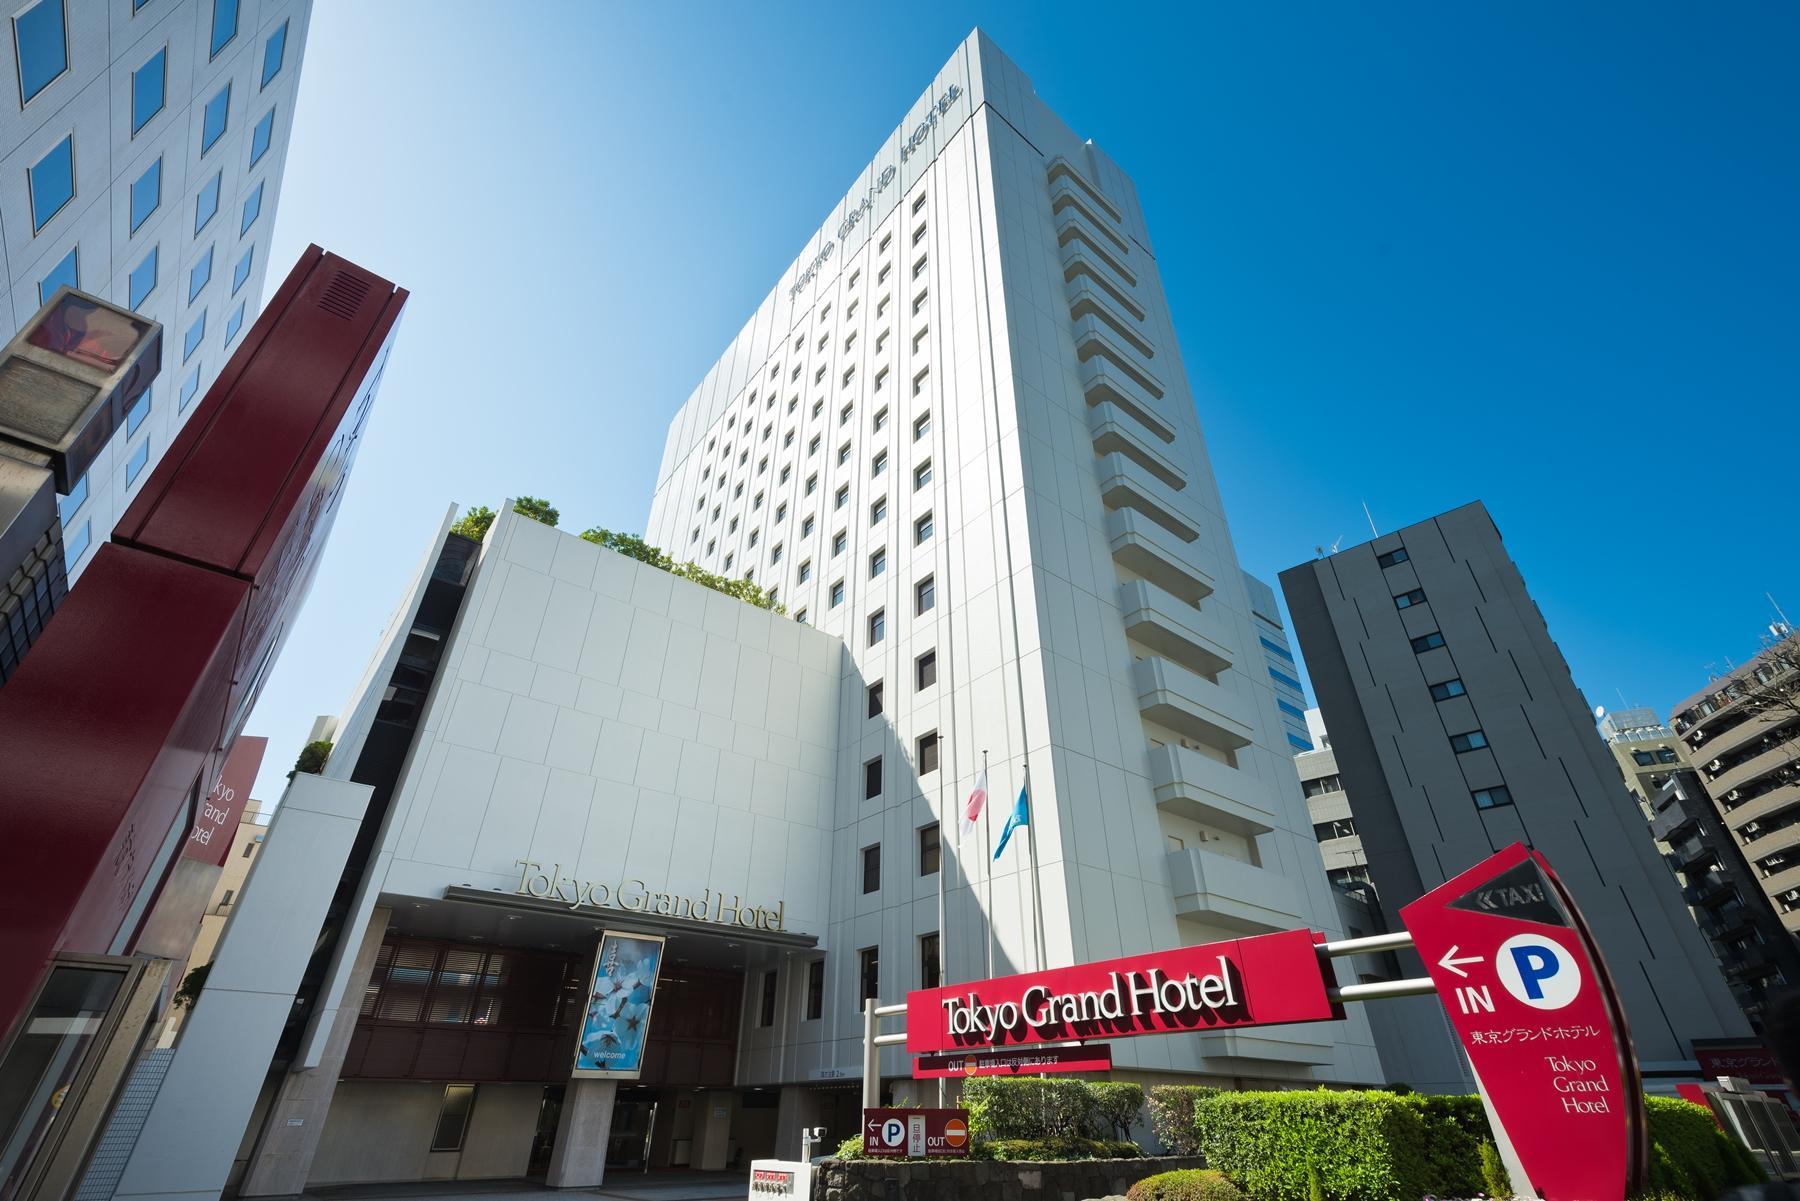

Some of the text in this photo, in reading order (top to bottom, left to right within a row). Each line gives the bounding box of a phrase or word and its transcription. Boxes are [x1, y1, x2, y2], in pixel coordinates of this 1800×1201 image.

[838, 163, 897, 241] GRAND
[900, 84, 964, 164] HOTEL
[515, 859, 785, 932] Tokyo Grand Hotel
[1495, 883, 1544, 907] TAXI
[1510, 945, 1560, 1000] P
[942, 955, 1239, 1041] Tokyo Grand Hotel
[1455, 985, 1496, 1015] IN
[1470, 1025, 1600, 1045] 東京グランドホテル
[593, 1050, 627, 1060] welcome
[948, 1060, 964, 1072] OUT
[1544, 1056, 1597, 1075] Tokyo
[1553, 1075, 1610, 1093] Grand
[1561, 1096, 1610, 1113] Hotel
[869, 1136, 879, 1147] IN
[887, 1123, 901, 1143] P
[912, 1117, 921, 1153] 一旦停止
[927, 1136, 945, 1147] OUT
